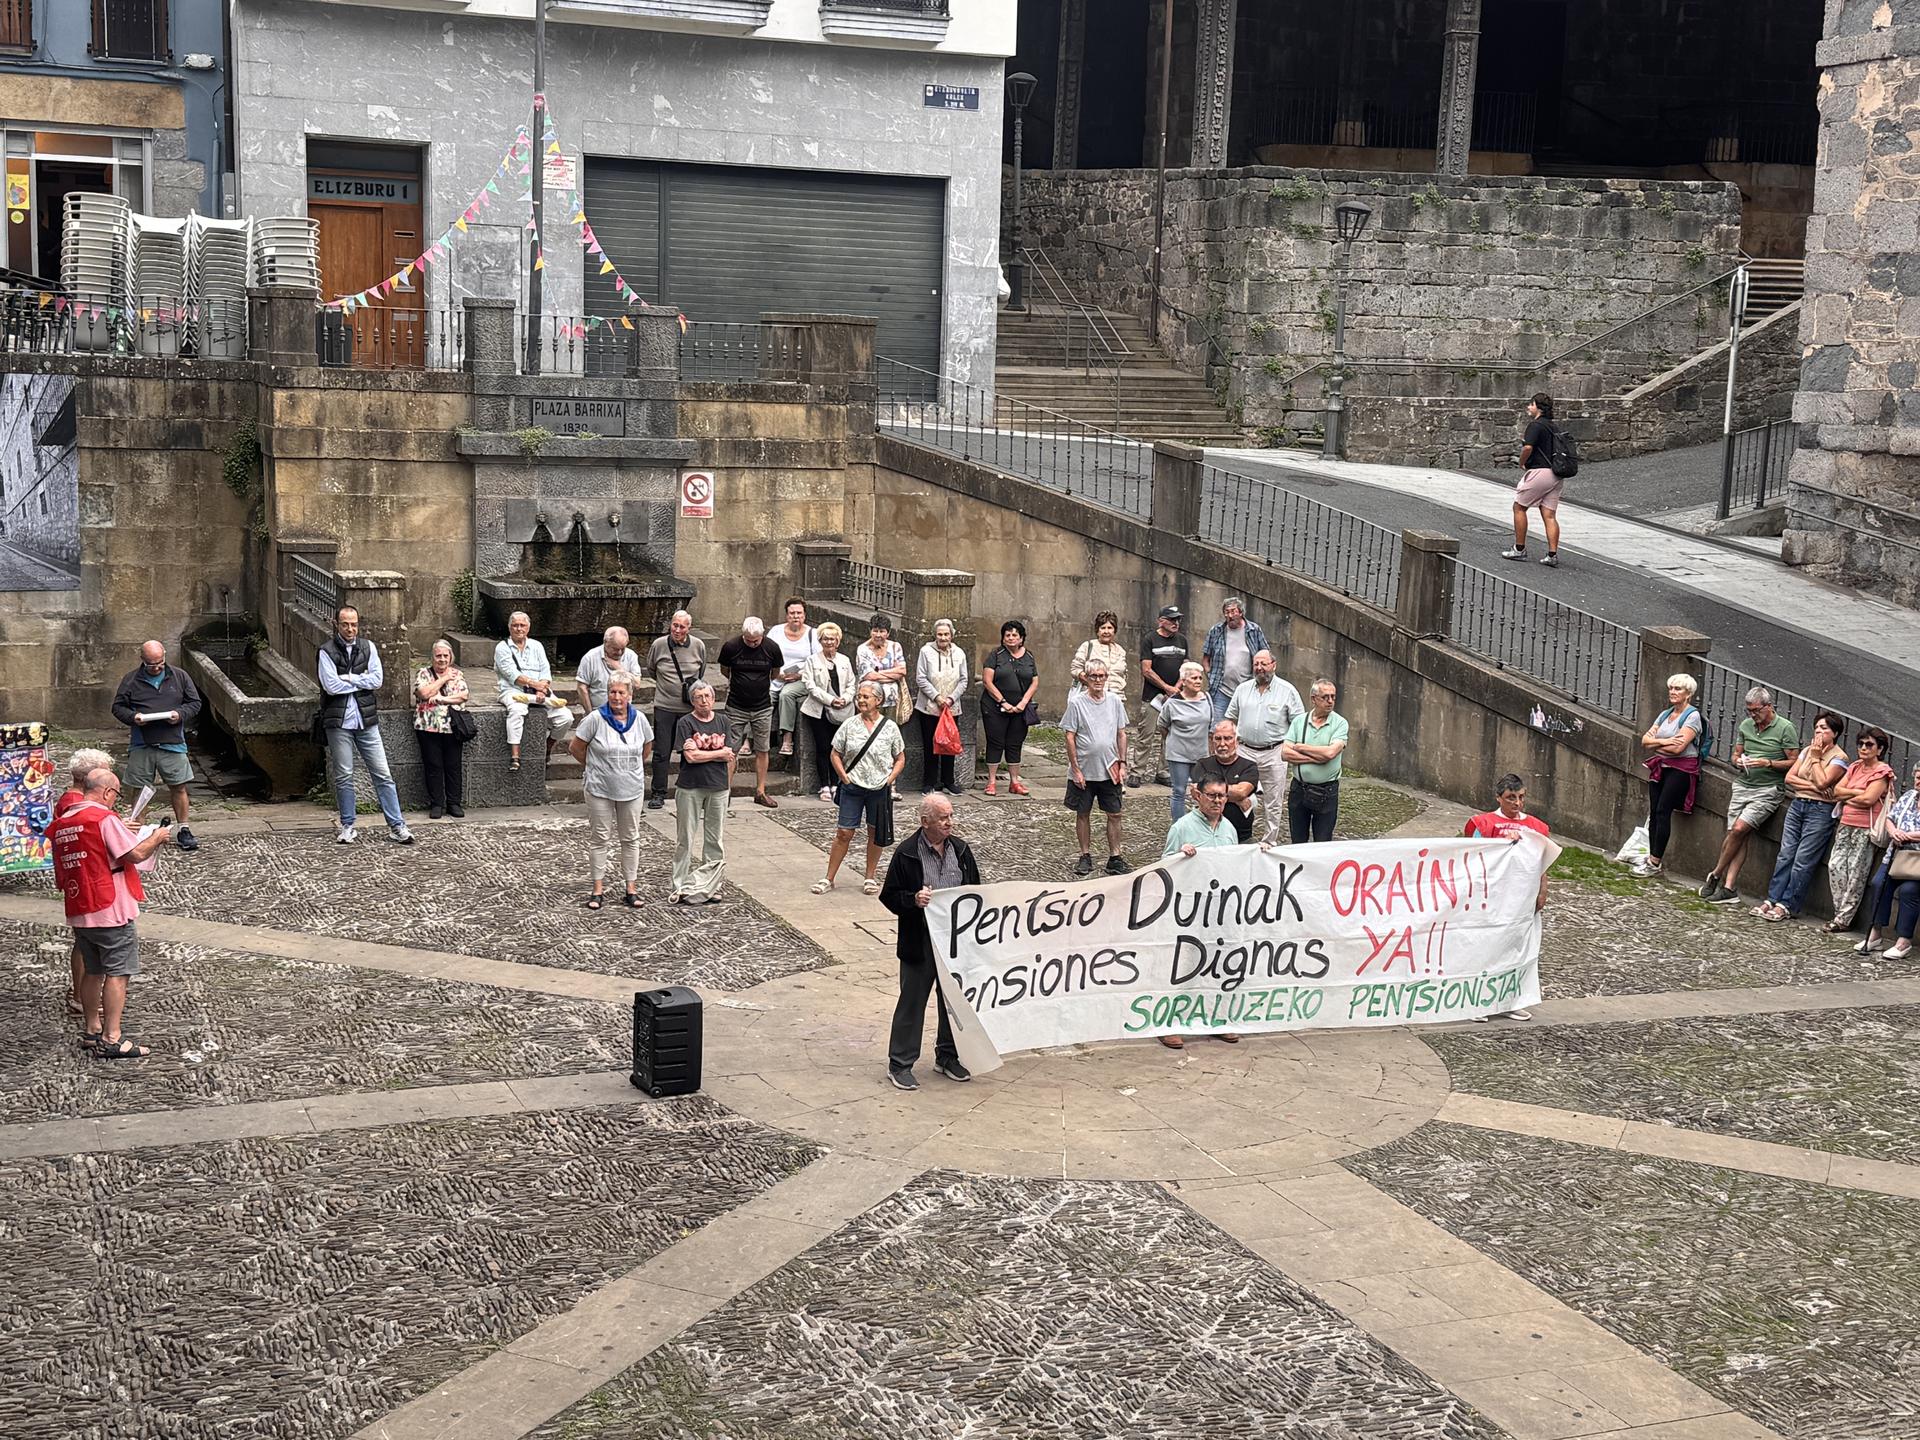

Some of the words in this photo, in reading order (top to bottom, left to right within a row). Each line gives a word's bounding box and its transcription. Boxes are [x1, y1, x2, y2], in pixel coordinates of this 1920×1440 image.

[314, 180, 395, 198] ELIZBURU
[402, 184, 408, 199] 1
[534, 401, 571, 417] PLAZA
[574, 402, 622, 418] BARRIXA
[950, 889, 1106, 959] Pentsio
[1170, 935, 1331, 992] Dignas
[1356, 921, 1448, 976] YA!!
[1123, 986, 1325, 1033] SORALUZEKO
